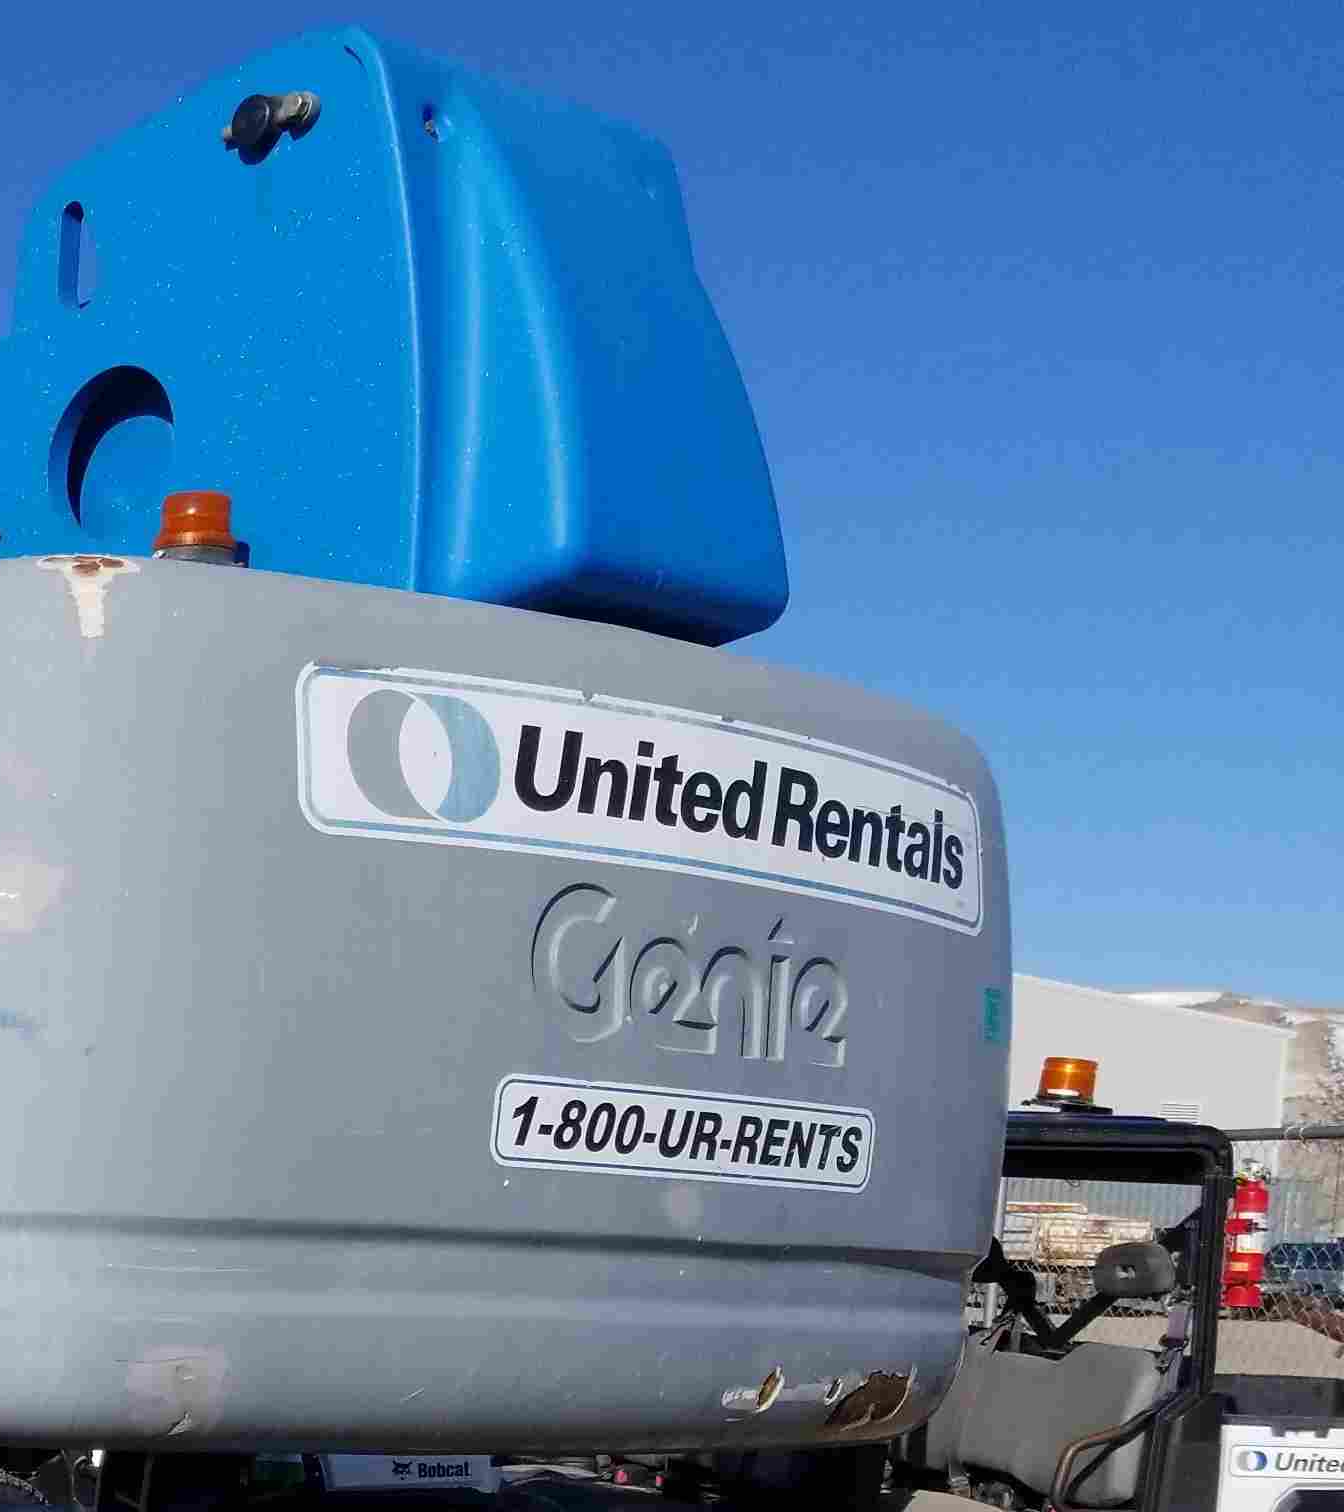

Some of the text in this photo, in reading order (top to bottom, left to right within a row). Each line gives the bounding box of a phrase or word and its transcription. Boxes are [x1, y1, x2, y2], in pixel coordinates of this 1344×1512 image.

[514, 725, 965, 890] United Rentals
[530, 882, 848, 1068] Genie
[512, 1096, 863, 1173] 1-800-UR-RENTS
[418, 1461, 470, 1478] Bobcat
[1275, 1451, 1344, 1473] Unite
